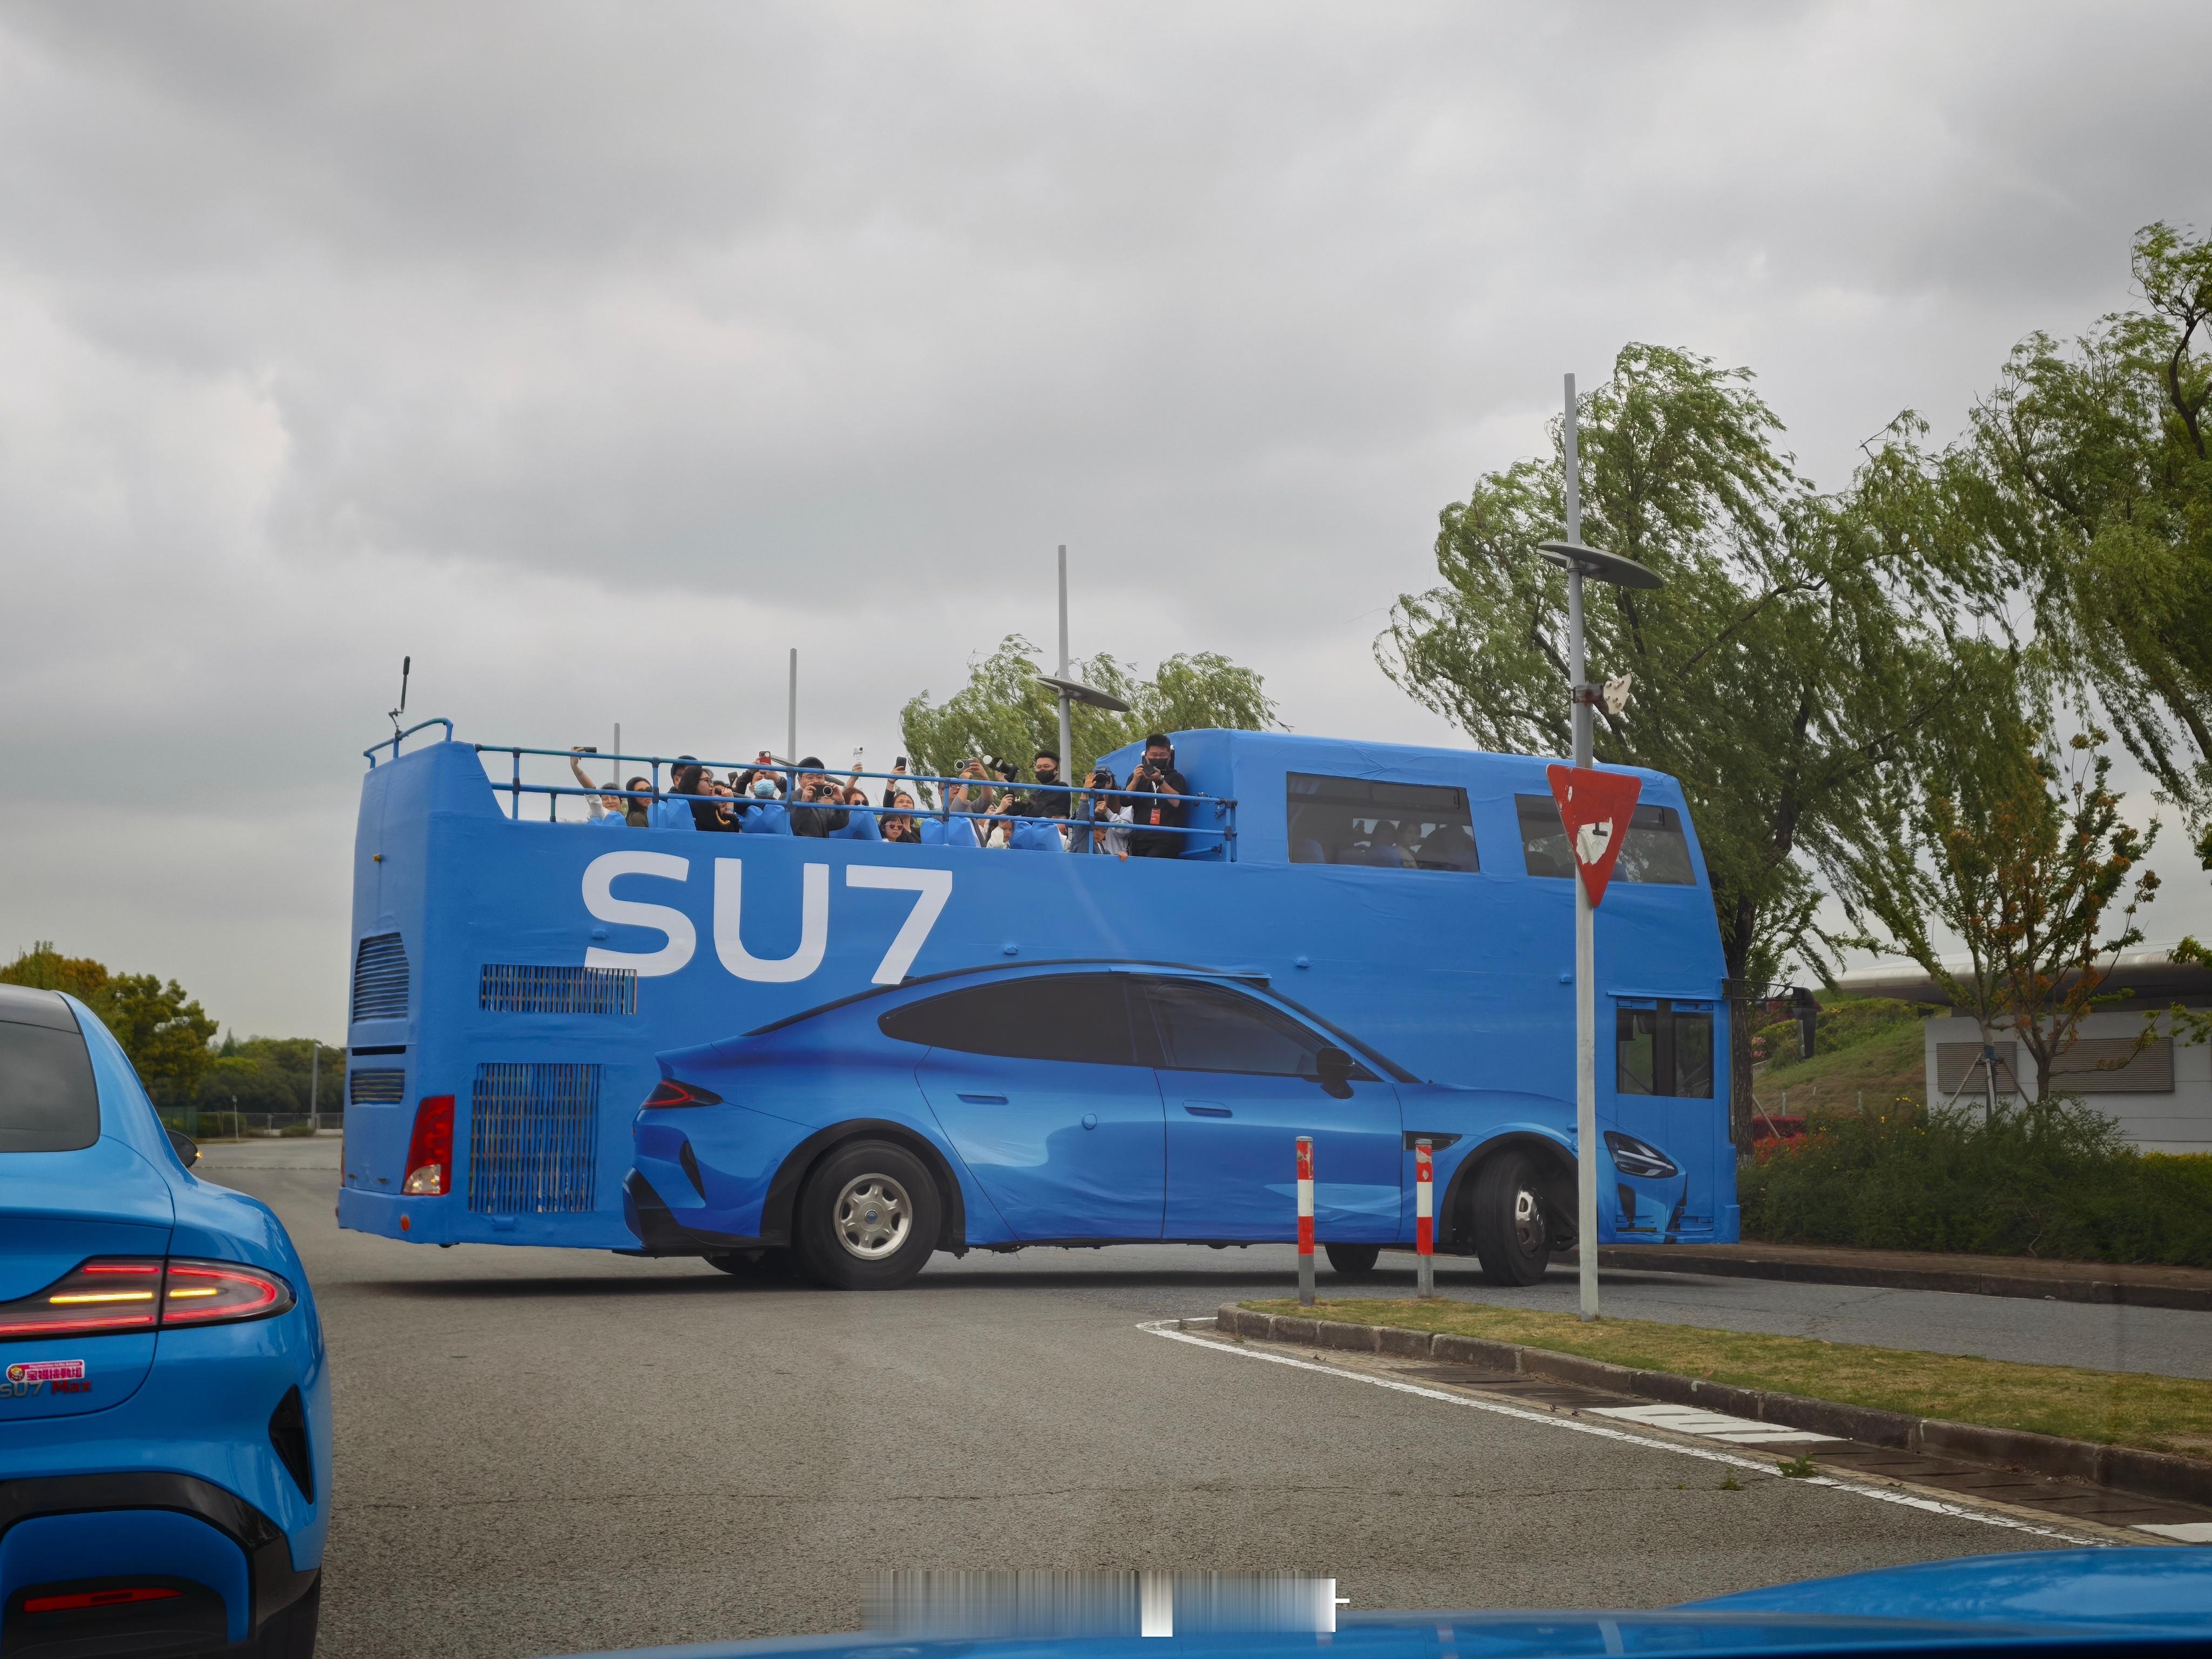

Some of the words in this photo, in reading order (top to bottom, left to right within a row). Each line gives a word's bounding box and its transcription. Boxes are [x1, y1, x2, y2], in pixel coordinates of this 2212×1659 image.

[582, 851, 953, 985] SU7
[0, 1381, 43, 1398] SU7
[52, 1379, 91, 1394] Max
